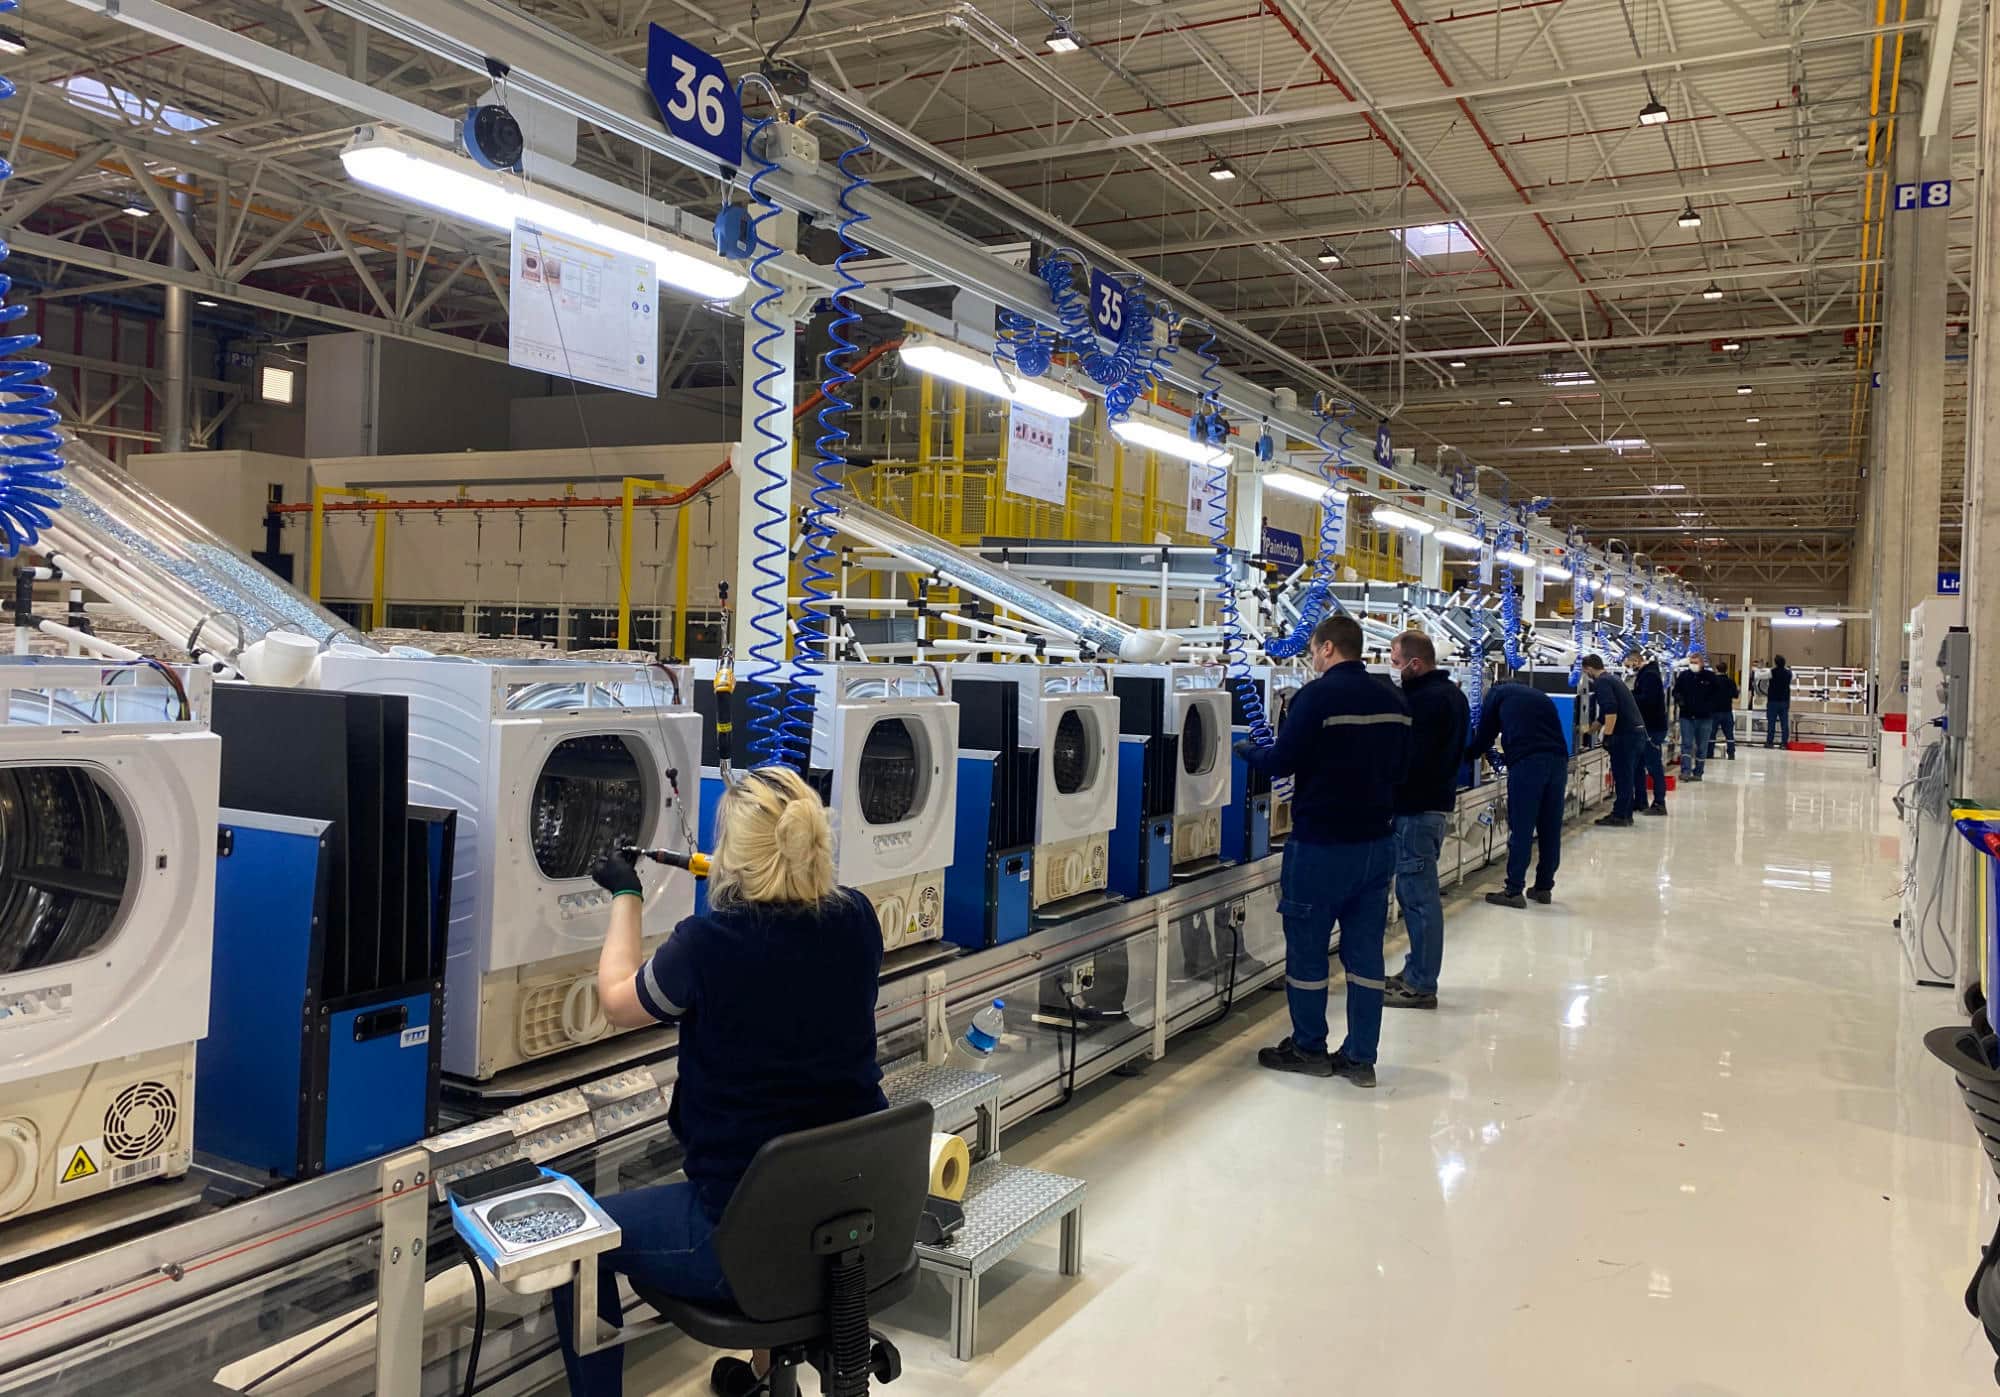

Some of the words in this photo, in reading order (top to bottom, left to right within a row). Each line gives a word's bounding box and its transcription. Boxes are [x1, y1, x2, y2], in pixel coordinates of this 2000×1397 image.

[667, 54, 725, 136] 36
[1899, 187, 1916, 208] P
[1928, 183, 1948, 205] 8
[1099, 284, 1122, 331] 35
[1380, 434, 1390, 461] 34
[1265, 537, 1298, 562] Paintshop
